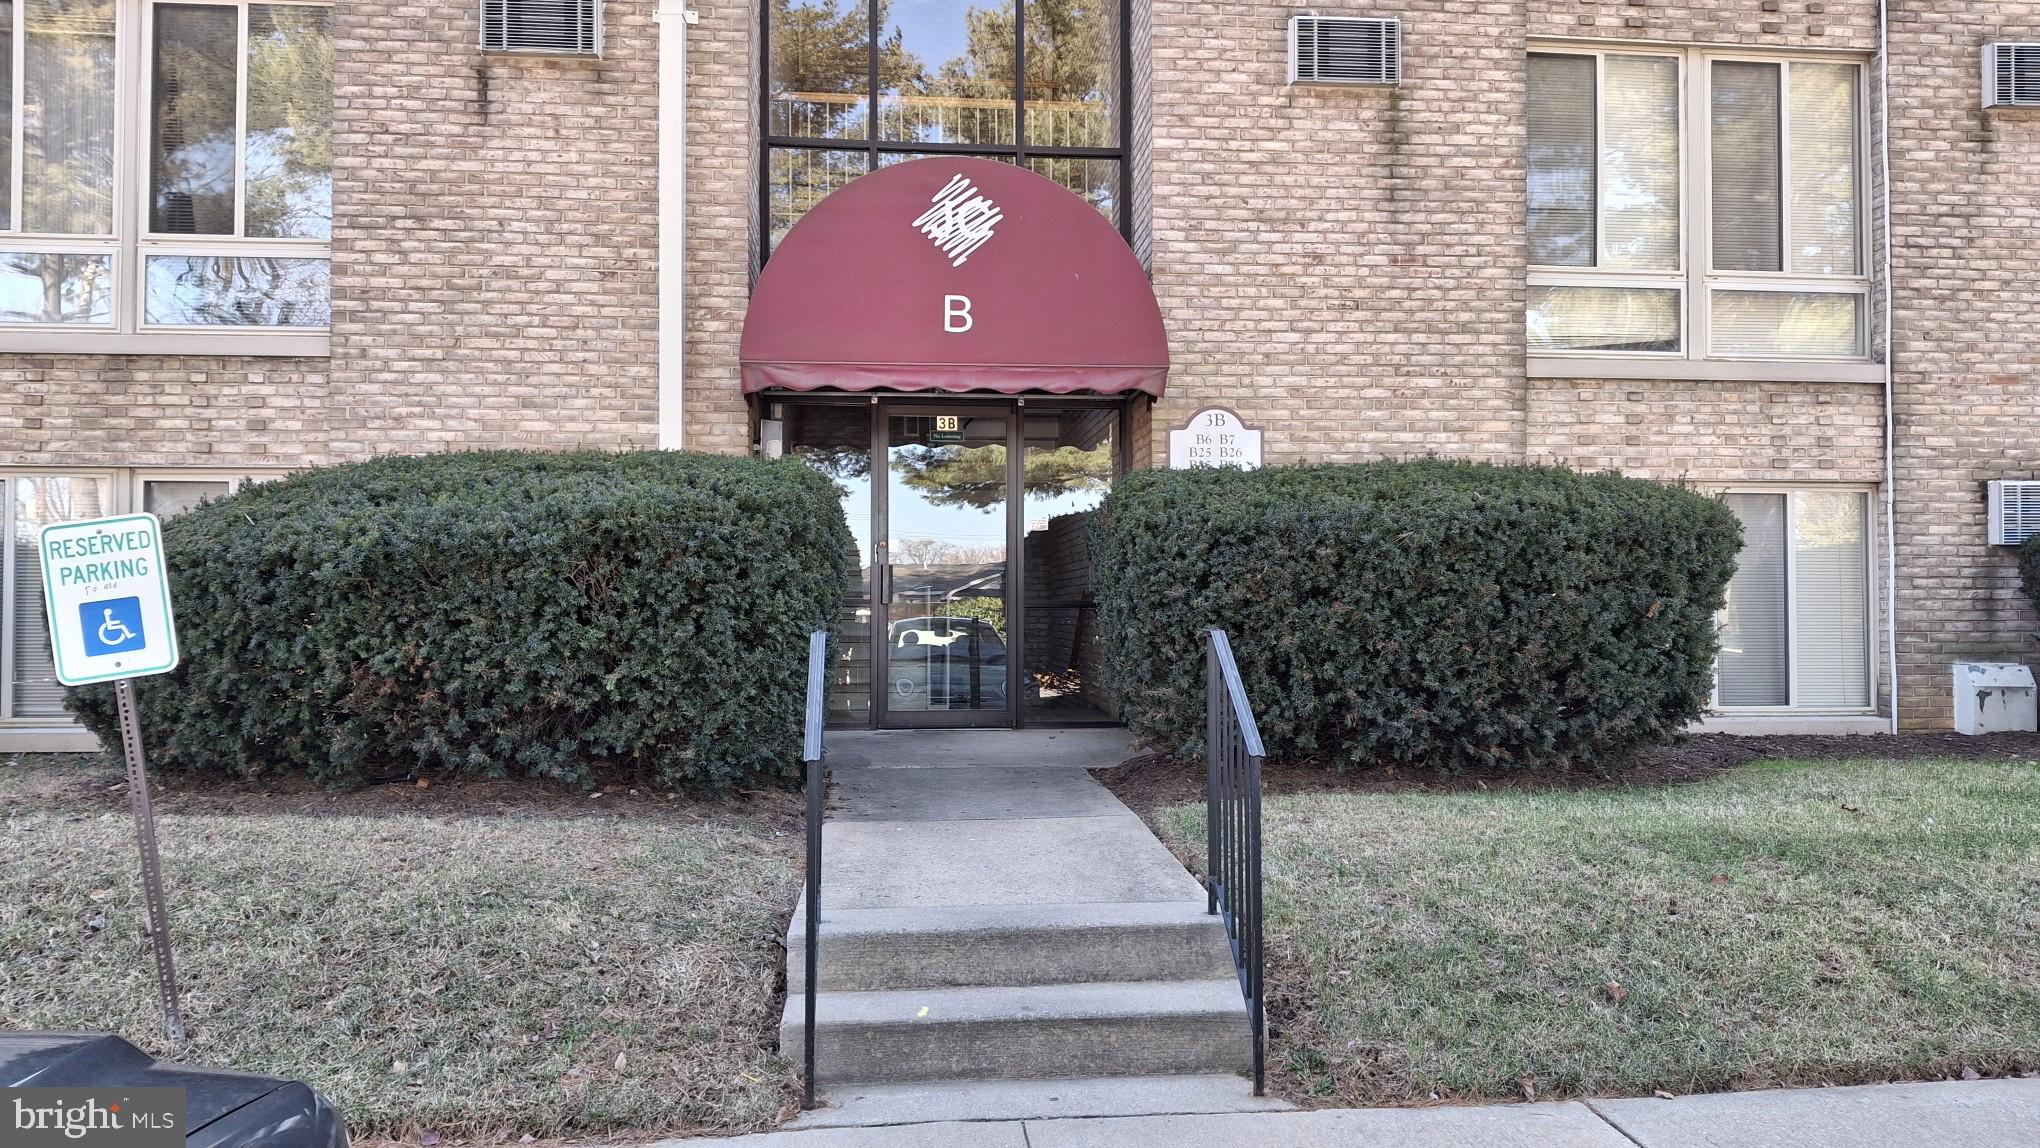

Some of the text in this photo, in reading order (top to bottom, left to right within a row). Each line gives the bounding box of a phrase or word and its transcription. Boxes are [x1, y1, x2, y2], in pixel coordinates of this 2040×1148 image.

[944, 294, 973, 332] B
[938, 417, 956, 430] 3B
[1205, 413, 1226, 427] 3B
[1196, 434, 1236, 445] B6 B7
[1188, 446, 1243, 458] B25 B26
[48, 530, 151, 560] RESERVED
[60, 557, 149, 587] PARKING
